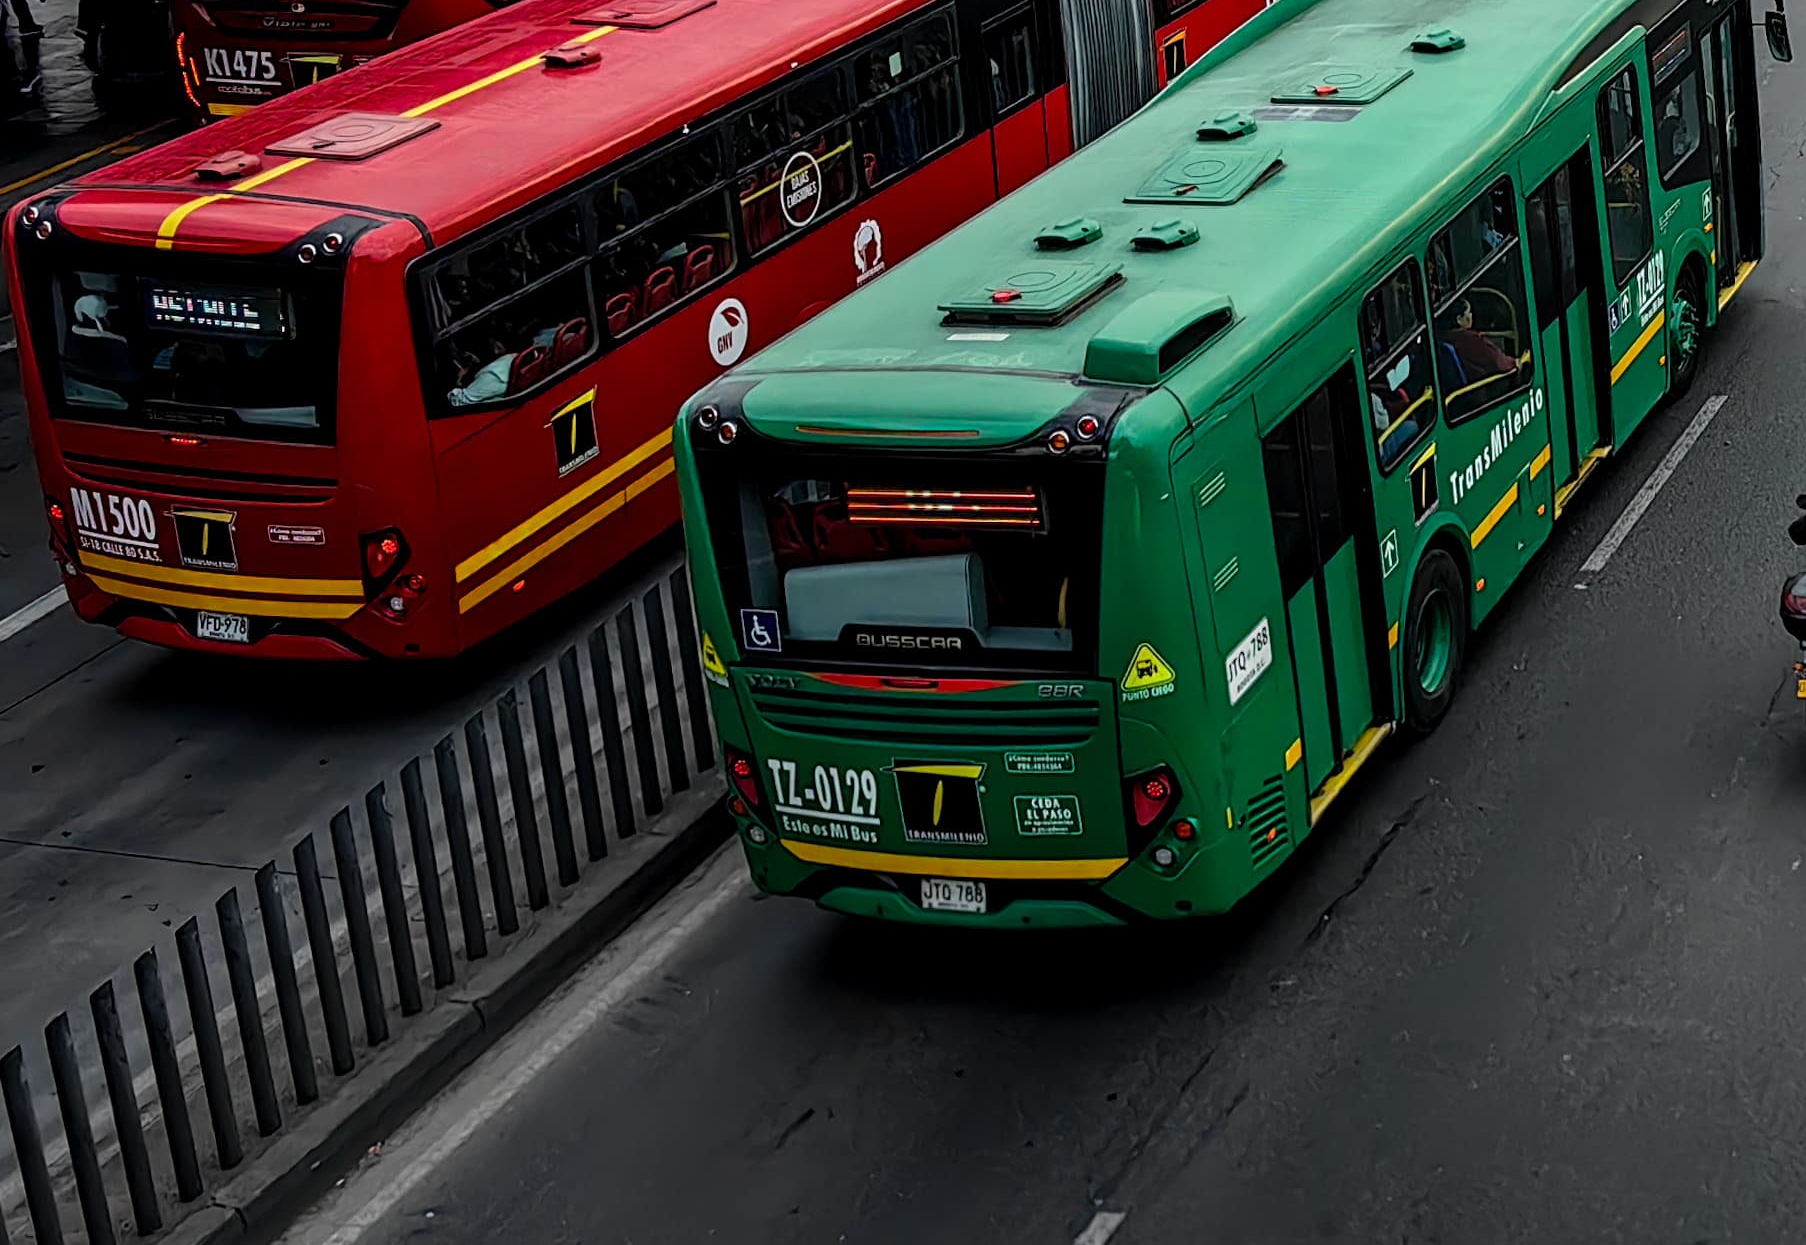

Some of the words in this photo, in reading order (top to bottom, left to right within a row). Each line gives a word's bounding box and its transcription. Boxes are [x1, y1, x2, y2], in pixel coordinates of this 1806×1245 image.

[204, 48, 276, 80] K1475
[717, 332, 734, 354] GNV
[1449, 387, 1543, 505] TransMilenio
[70, 487, 156, 541] M1500
[856, 633, 962, 650] BUSSCAR
[1122, 689, 1149, 703] PUNTO
[1151, 683, 1174, 698] CIEGO
[767, 758, 878, 816] TZ-0129
[1027, 809, 1039, 820] EL
[1042, 808, 1071, 820] PASO
[1031, 798, 1060, 809] CEDA
[782, 815, 810, 835] Este
[814, 823, 828, 837] es
[852, 827, 878, 843] Bus
[908, 829, 984, 843] TRANSMILENIO
